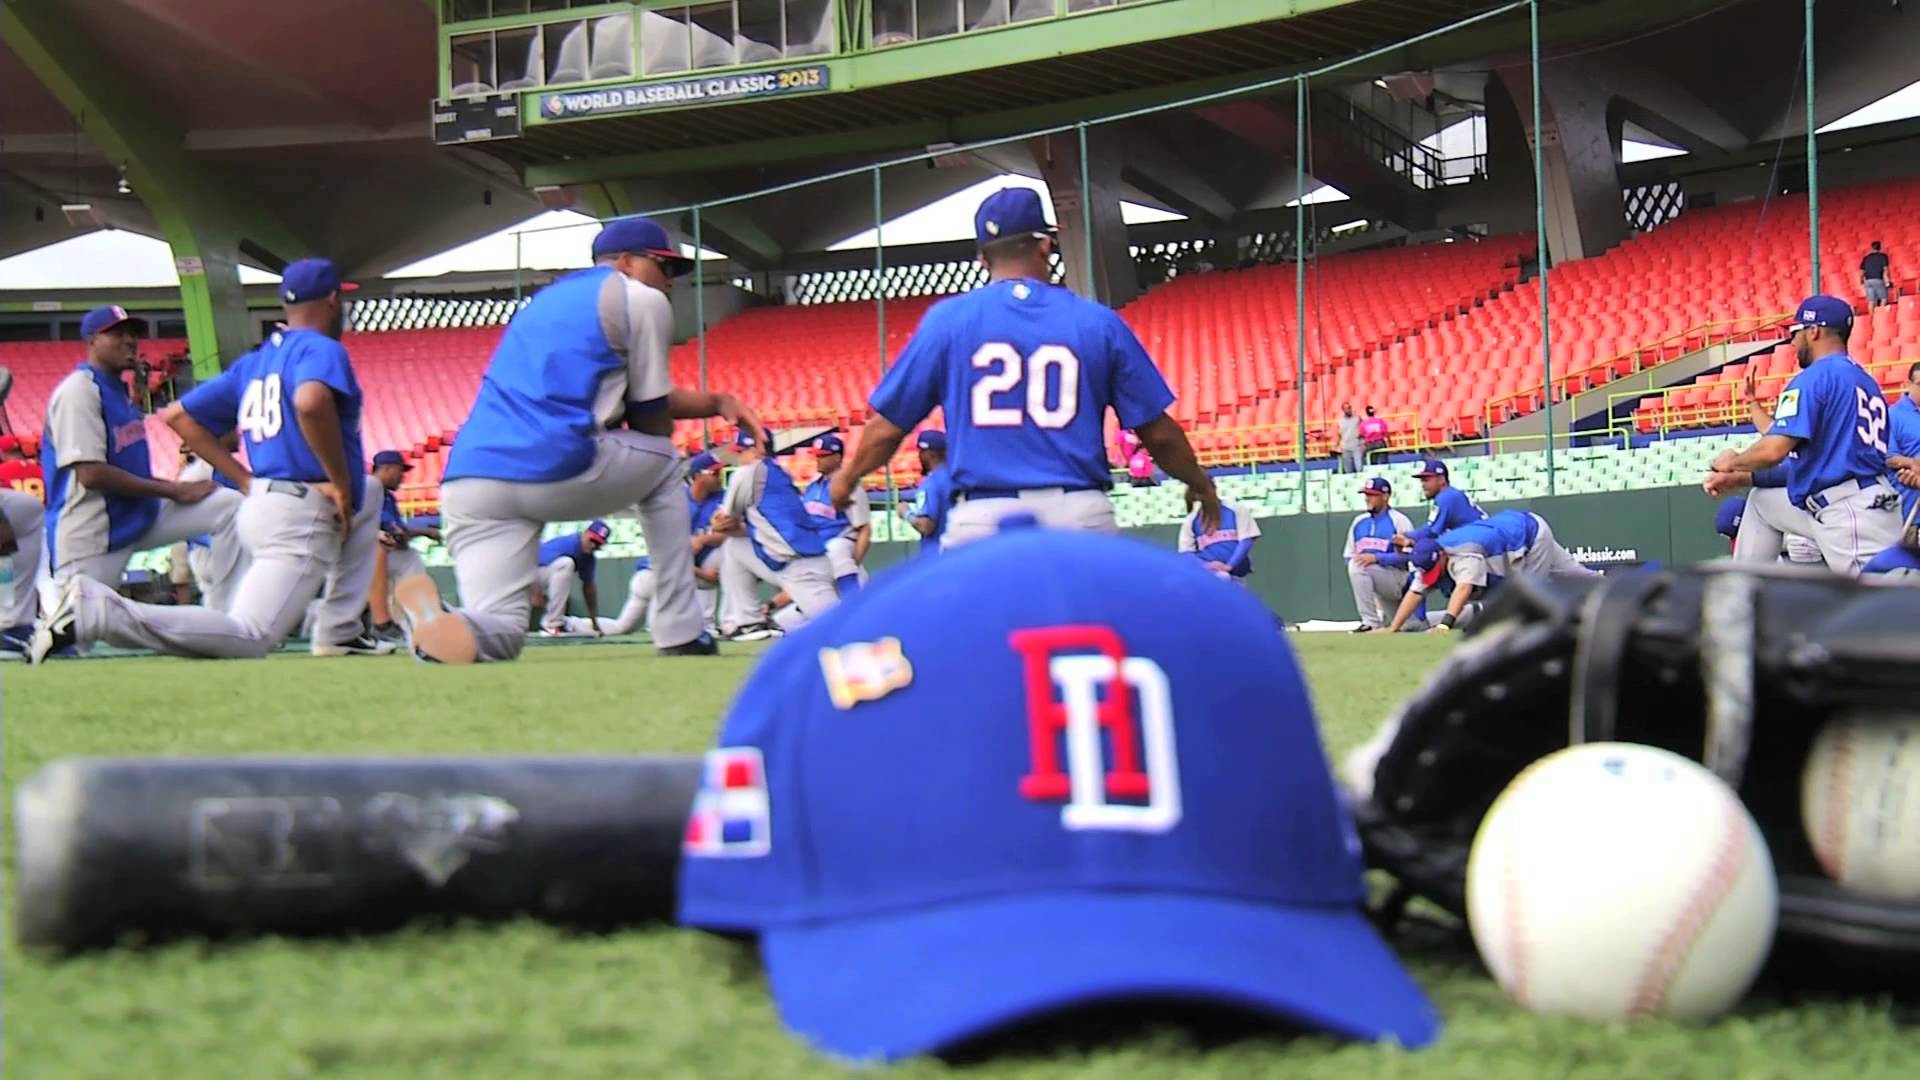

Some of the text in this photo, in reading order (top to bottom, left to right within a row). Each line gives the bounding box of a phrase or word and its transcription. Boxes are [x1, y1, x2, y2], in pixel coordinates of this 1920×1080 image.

[564, 69, 820, 111] WORLD BASEBALL CLASSIC 2013
[237, 372, 283, 443] 48
[971, 342, 1080, 429] 20
[1856, 386, 1888, 454] 52
